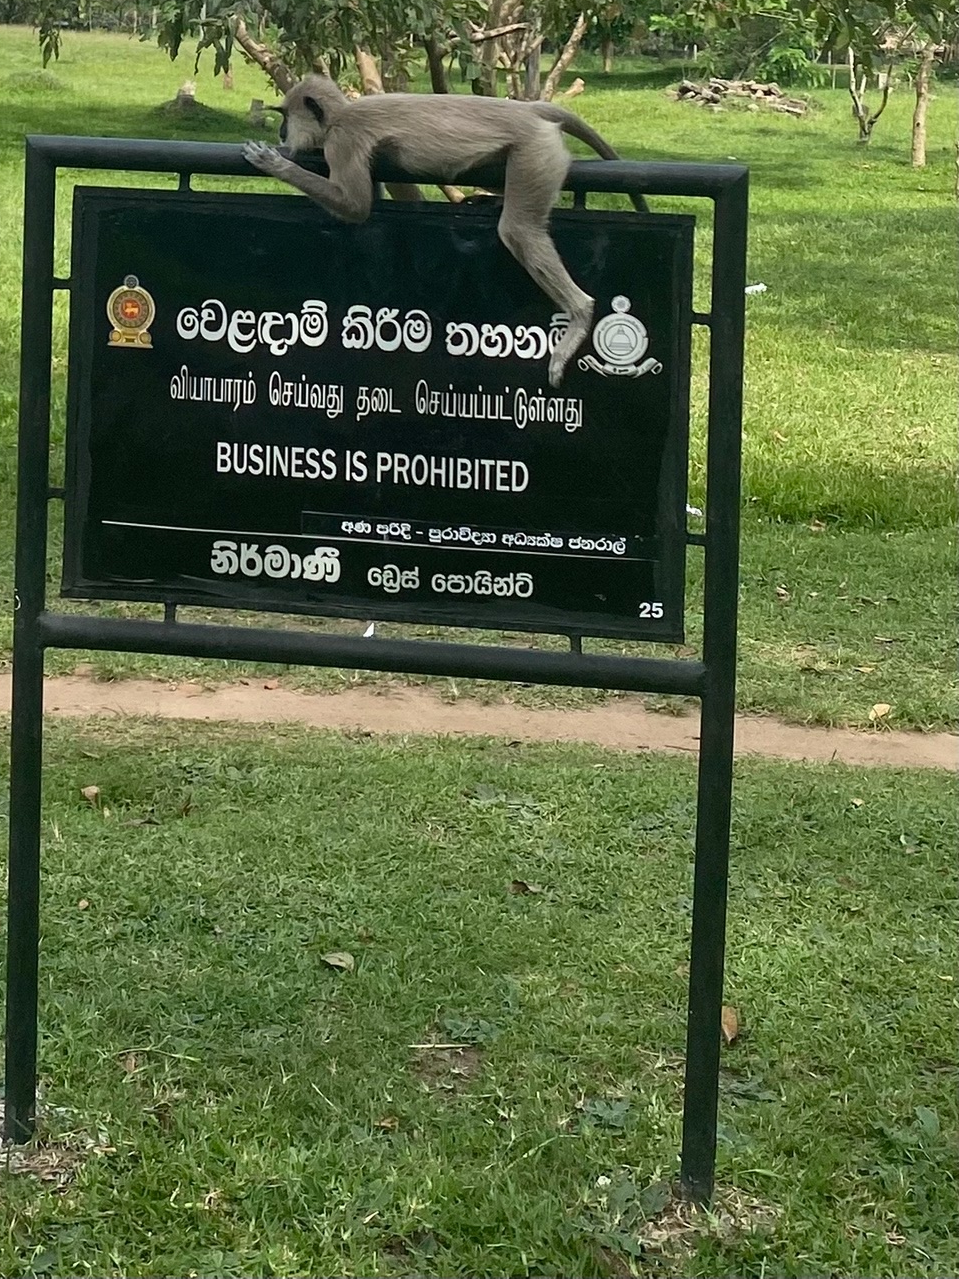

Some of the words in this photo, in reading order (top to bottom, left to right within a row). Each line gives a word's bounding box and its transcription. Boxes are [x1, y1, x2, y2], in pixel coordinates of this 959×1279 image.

[177, 299, 328, 355] වෙළඳාම්
[341, 305, 432, 352] කිරීම
[171, 365, 256, 411] வியாபாரம்
[269, 371, 343, 418] செய்வது
[357, 387, 401, 421] தடை
[415, 379, 583, 432] செய்யப்பட்டுள்ளது
[217, 442, 336, 479] BUSINESS
[345, 450, 368, 482] IS
[377, 453, 528, 491] PROHIBITED
[639, 603, 663, 618] 25
